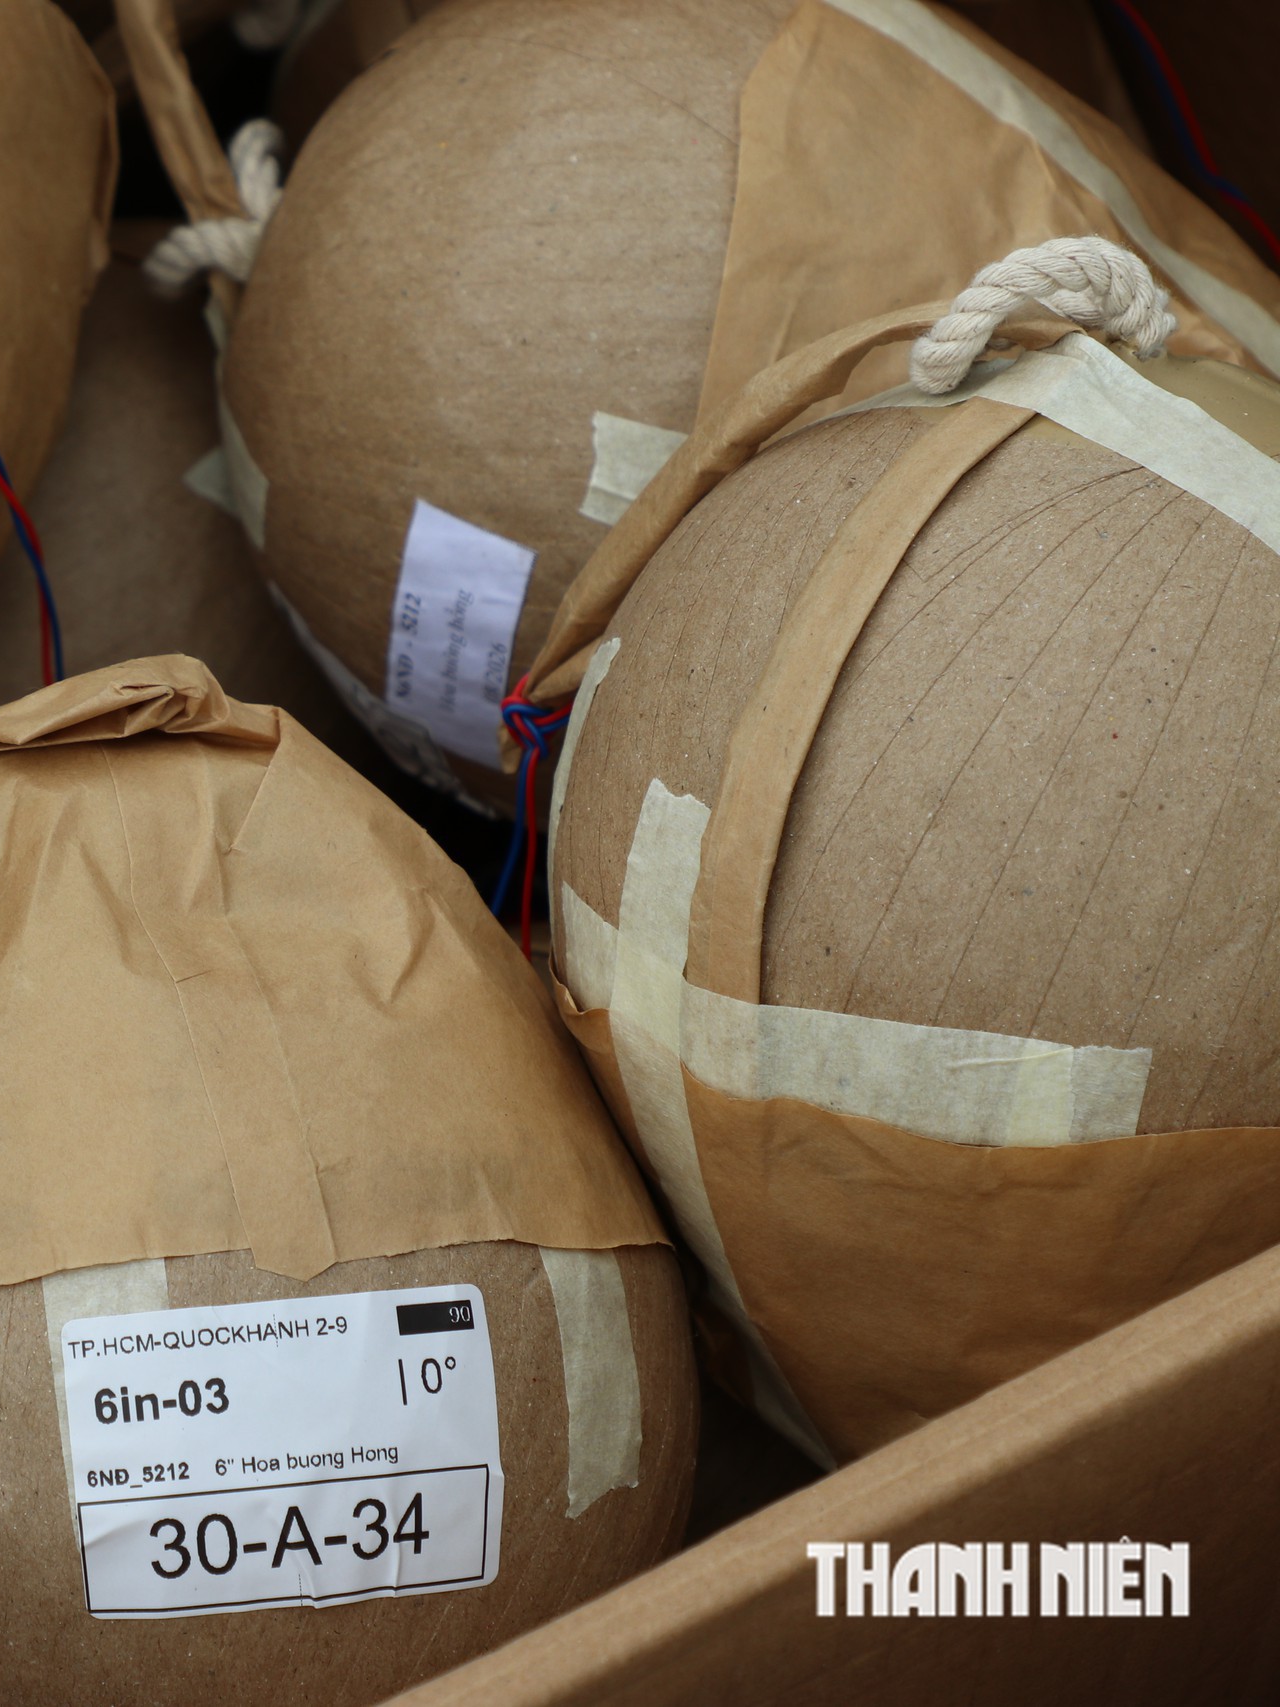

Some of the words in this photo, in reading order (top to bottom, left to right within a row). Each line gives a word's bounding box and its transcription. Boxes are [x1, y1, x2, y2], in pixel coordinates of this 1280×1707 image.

[67, 1320, 311, 1359] TP.HCM-QUOCKHANH
[316, 1315, 349, 1337] 2-9
[449, 1304, 472, 1324] 90
[93, 1377, 231, 1425] 6in-03
[86, 1461, 191, 1491] 6NĐ_5212
[214, 1457, 235, 1477] 6"
[240, 1455, 281, 1475] Hoa
[286, 1448, 346, 1474] buong
[350, 1444, 400, 1467] Hong
[149, 1491, 430, 1579] 30-A-34
